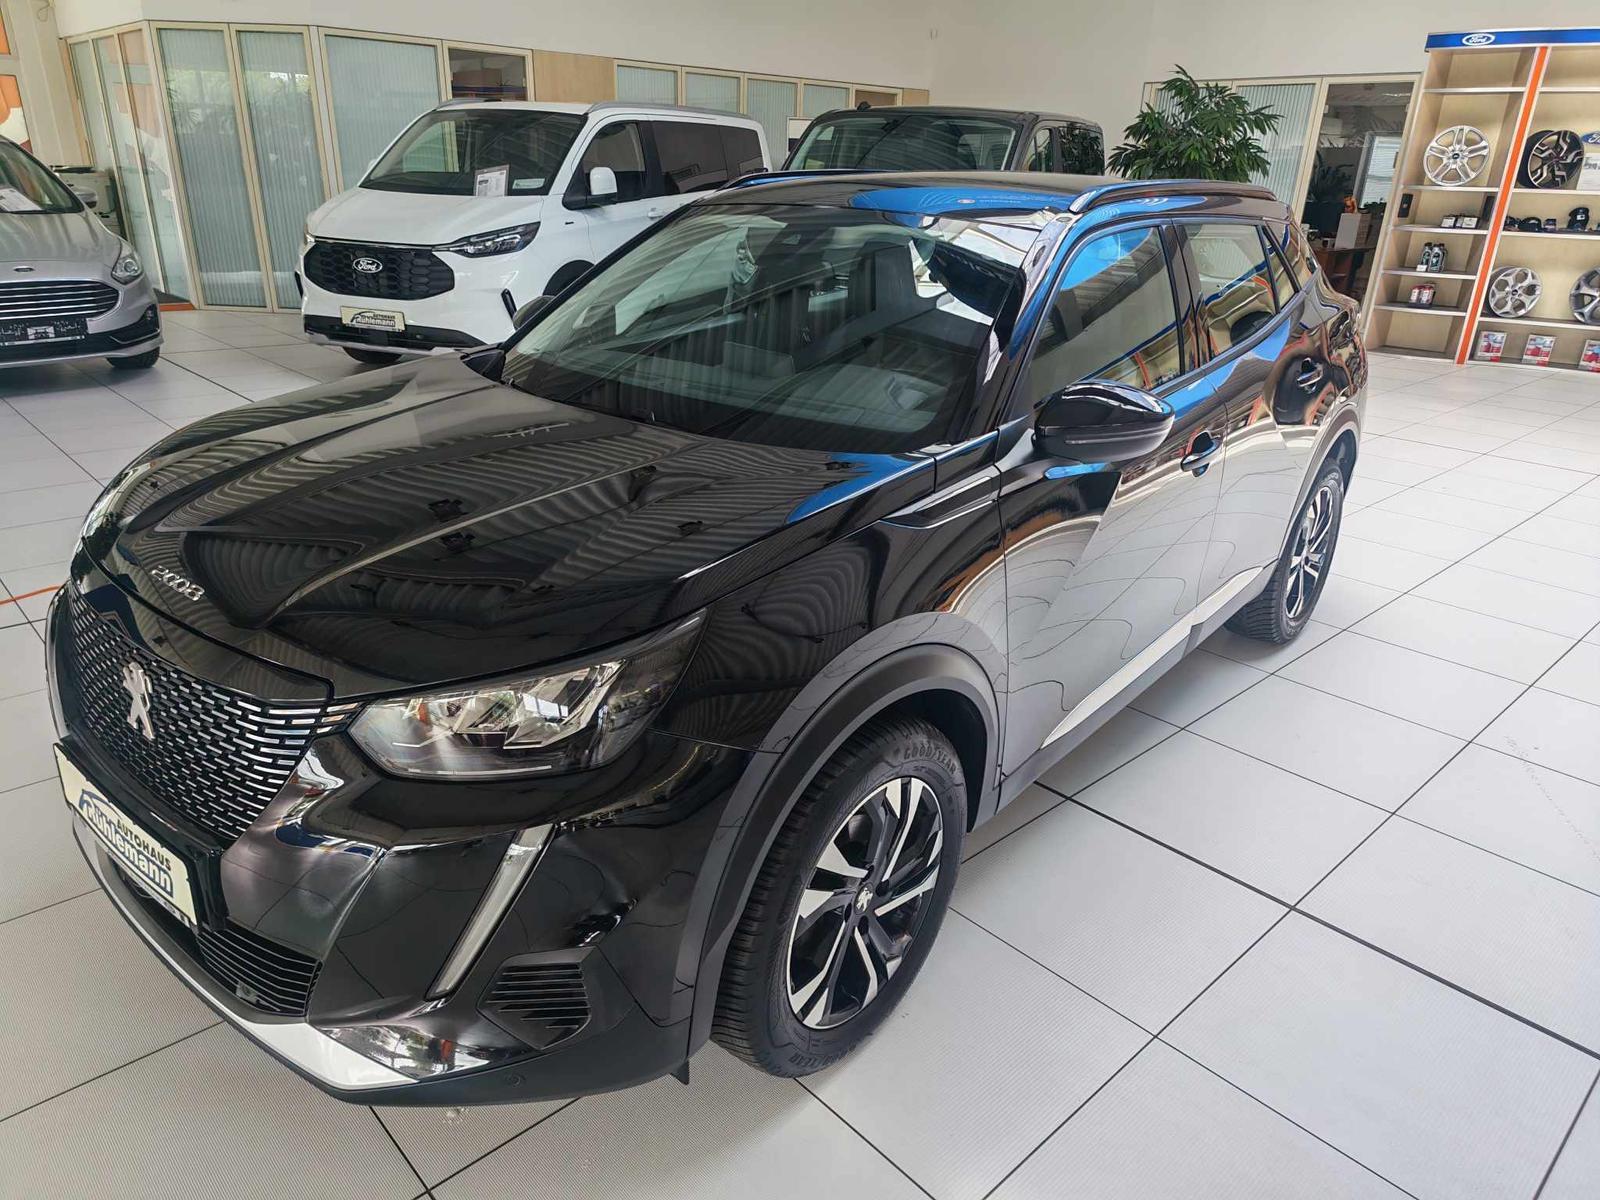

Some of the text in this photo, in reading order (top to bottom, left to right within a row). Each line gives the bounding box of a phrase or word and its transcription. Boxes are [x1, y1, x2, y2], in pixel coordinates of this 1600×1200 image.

[356, 258, 379, 272] Ford
[151, 565, 205, 601] 2008
[116, 818, 172, 871] AUTOHAUS
